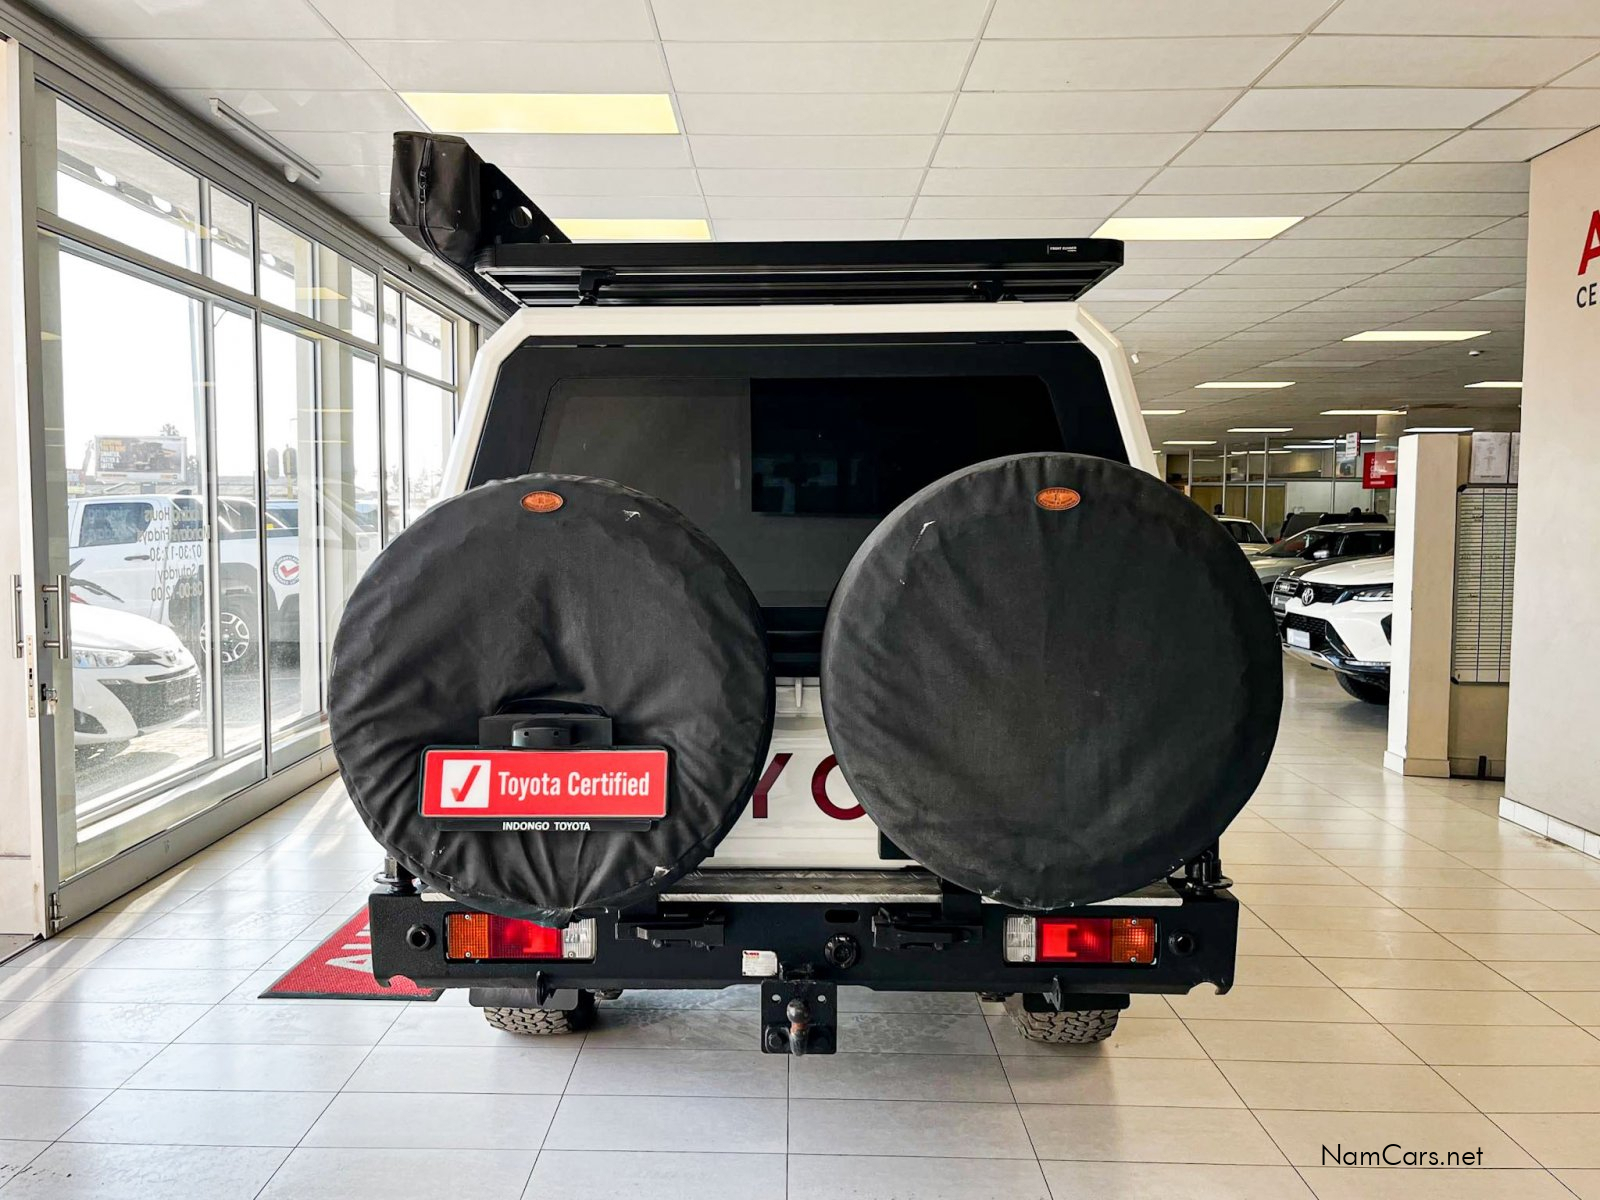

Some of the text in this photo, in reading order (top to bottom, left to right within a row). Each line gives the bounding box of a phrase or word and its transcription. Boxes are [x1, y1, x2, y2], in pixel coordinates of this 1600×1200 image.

[1576, 282, 1600, 308] CE
[498, 771, 650, 801] Toyota Certified
[752, 752, 867, 820] YO
[502, 821, 591, 831] INDONGO TOYOTA
